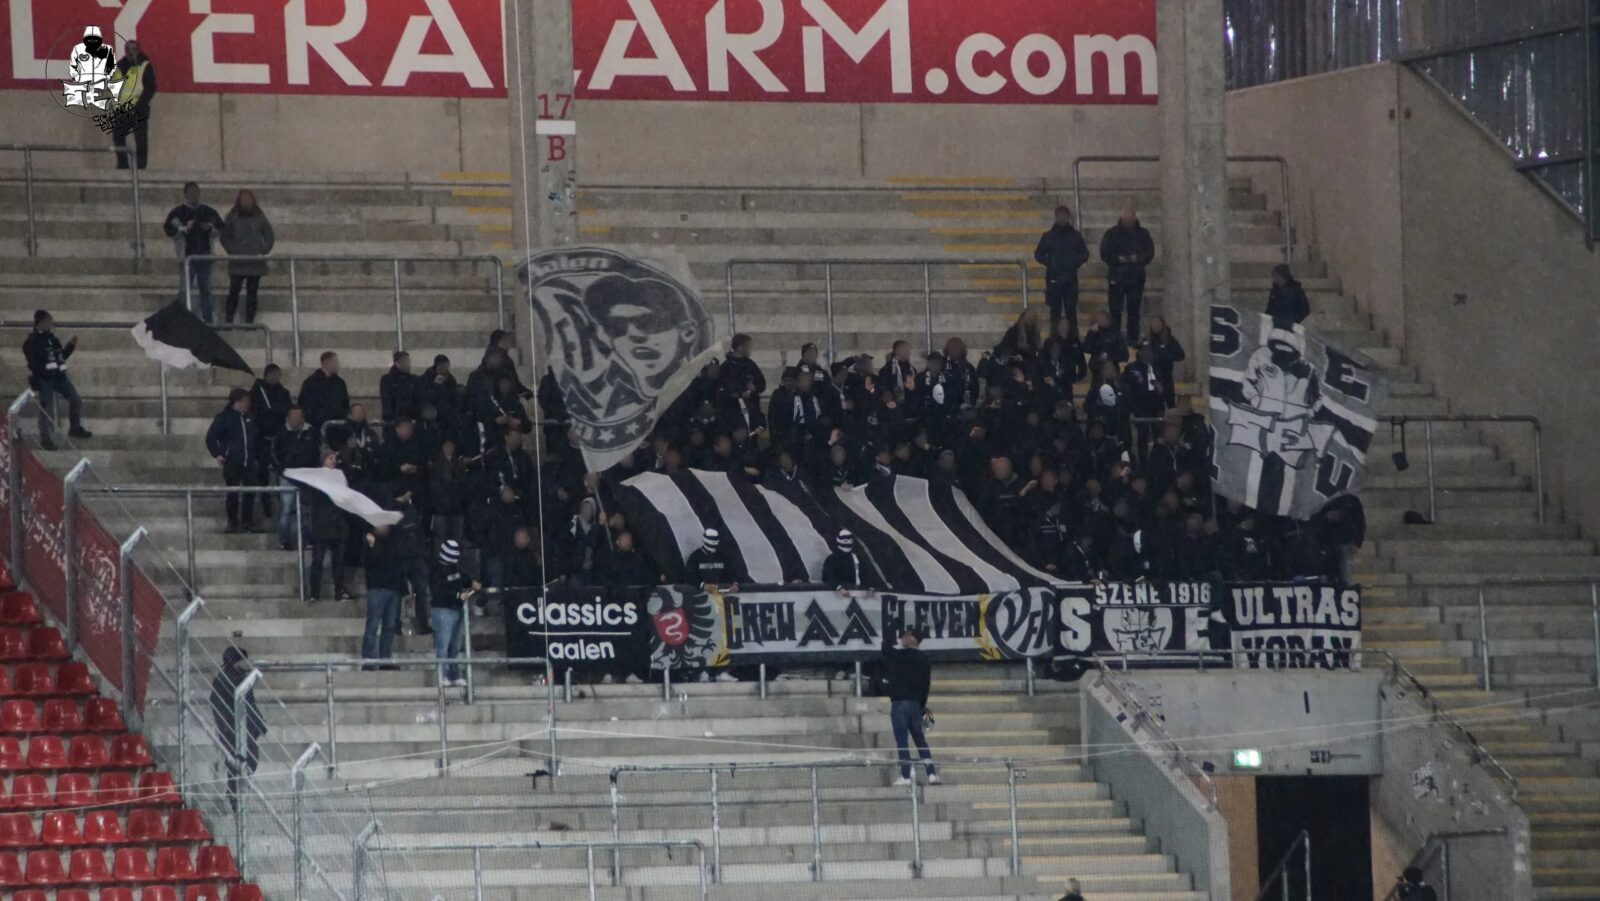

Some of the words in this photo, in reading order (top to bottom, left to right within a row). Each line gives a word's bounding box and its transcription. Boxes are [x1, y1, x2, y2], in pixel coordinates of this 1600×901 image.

[537, 93, 572, 120] 17
[546, 135, 566, 161] B
[1095, 583, 1160, 604] SZENE
[1168, 582, 1210, 604] 1916
[1232, 586, 1359, 626] ULTRAS
[516, 596, 638, 626] classics
[724, 595, 797, 649] CREW
[548, 639, 615, 660] aalen
[1241, 635, 1353, 669] VORAN
